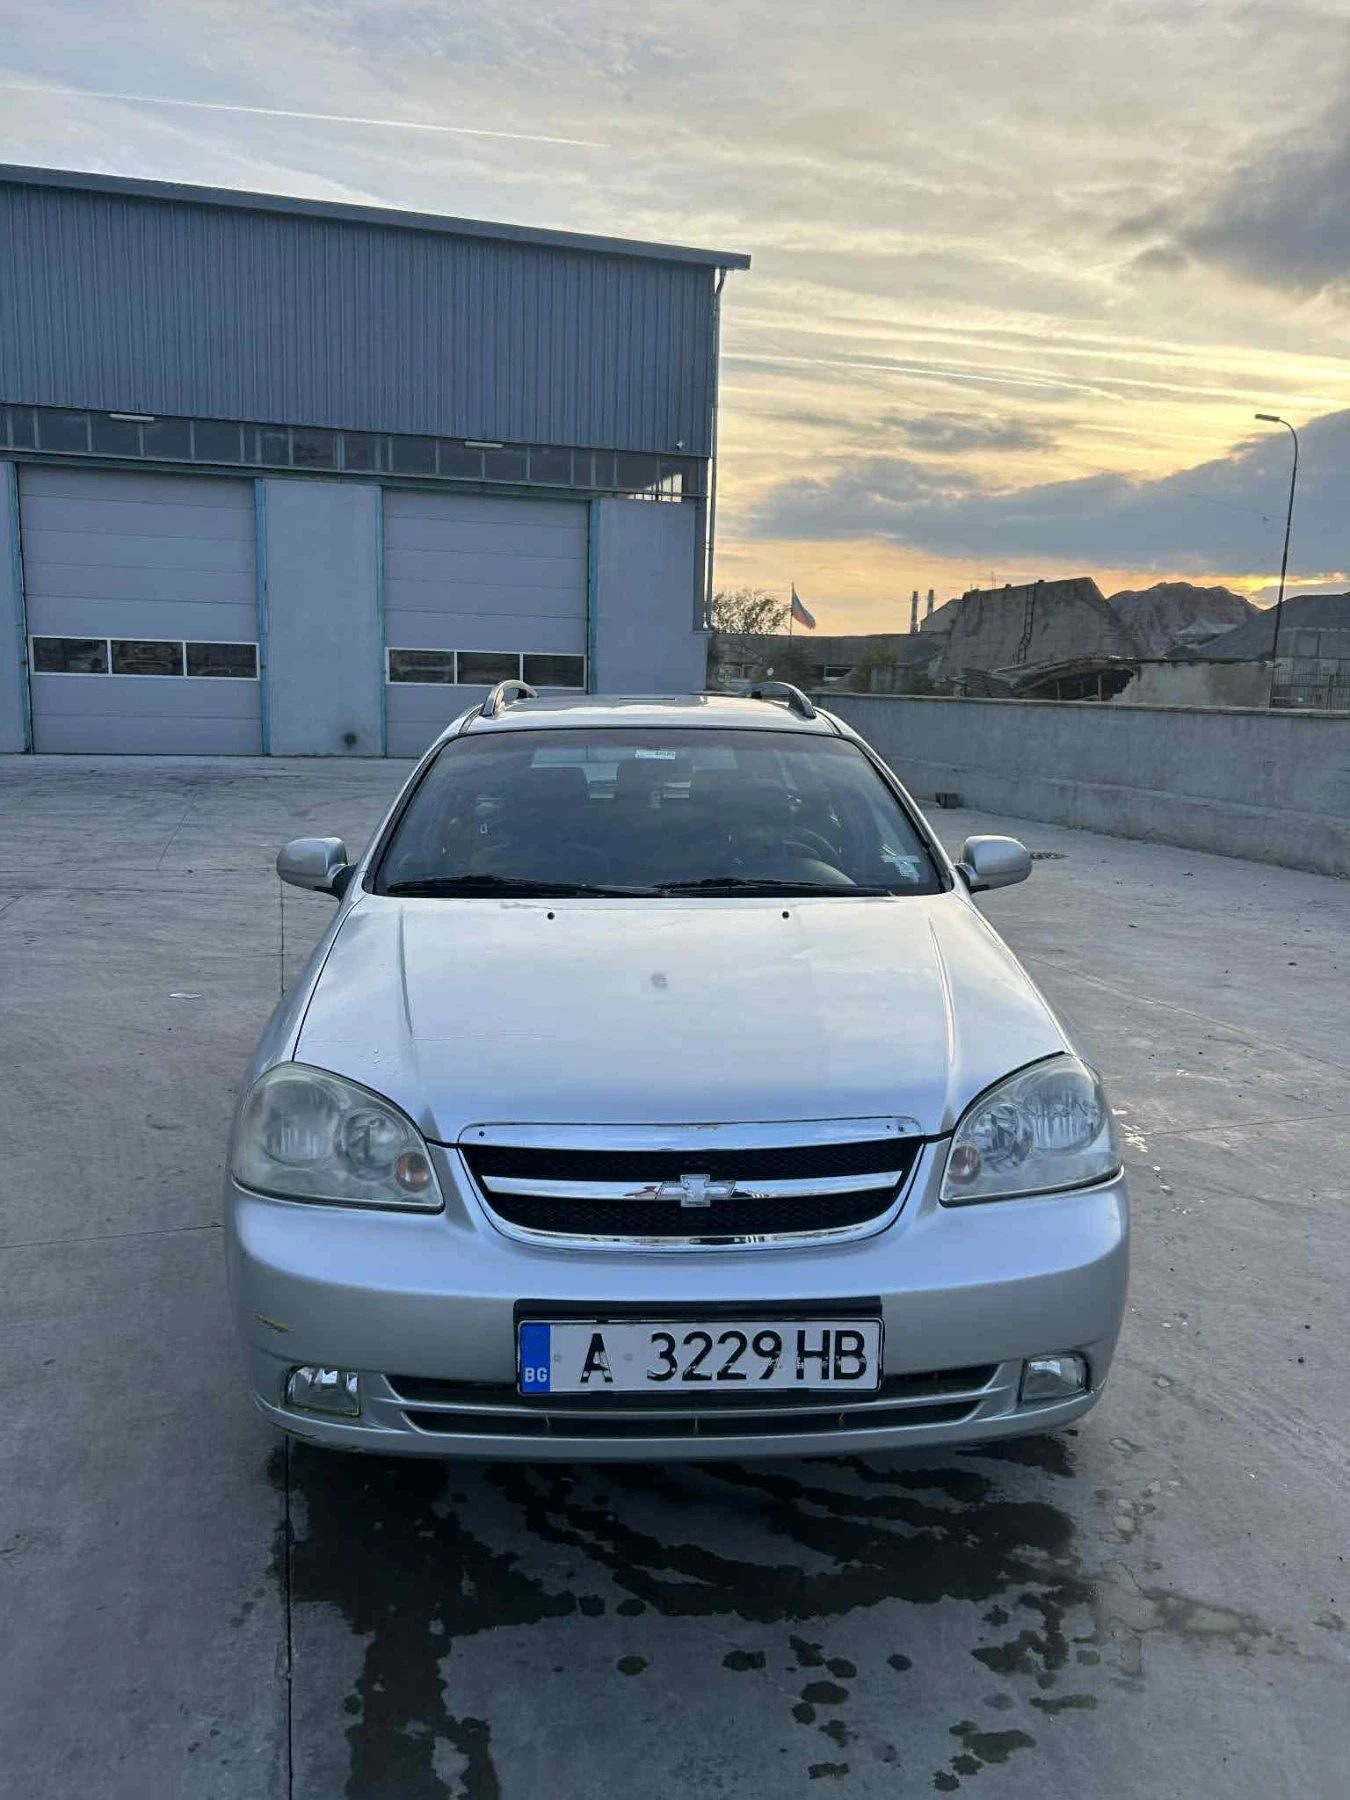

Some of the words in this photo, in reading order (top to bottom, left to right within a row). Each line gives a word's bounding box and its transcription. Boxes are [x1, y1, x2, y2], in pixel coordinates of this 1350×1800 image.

[580, 1333, 613, 1383] A
[647, 1330, 782, 1382] 3229
[796, 1329, 867, 1381] HB
[524, 1367, 548, 1383] BG
